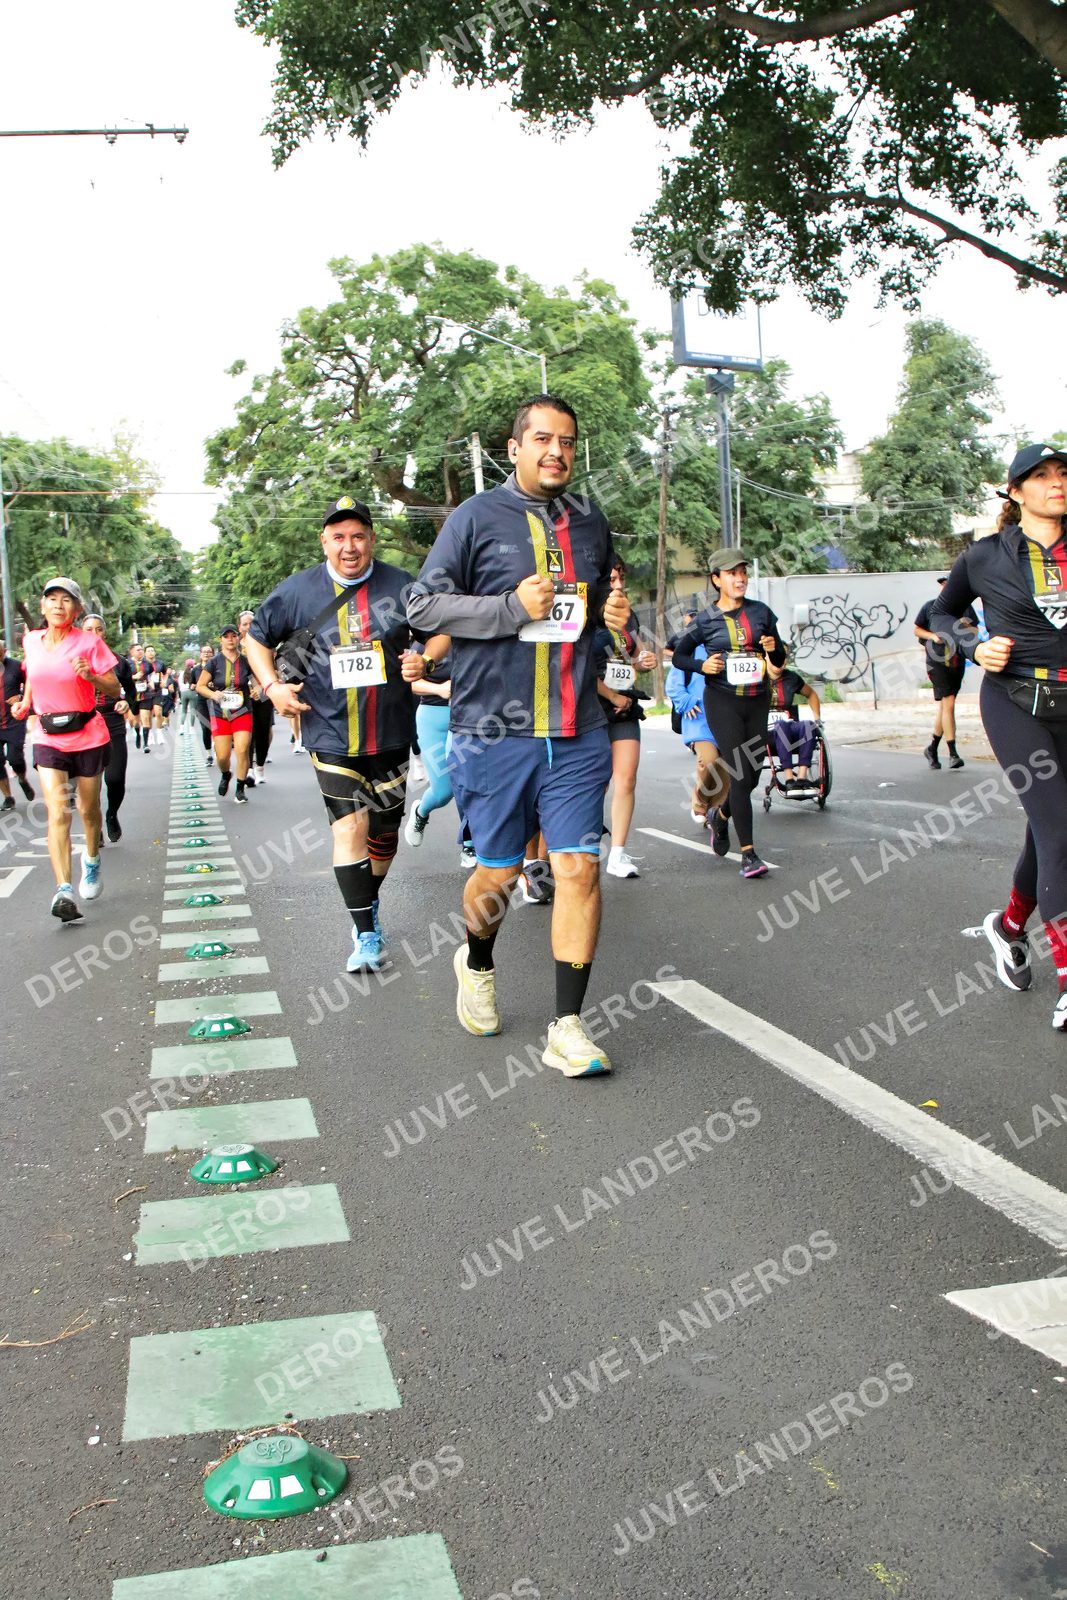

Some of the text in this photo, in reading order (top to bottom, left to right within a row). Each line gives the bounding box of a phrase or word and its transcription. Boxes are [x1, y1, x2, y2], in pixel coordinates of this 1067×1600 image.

[809, 593, 850, 608] TOY
[338, 656, 373, 673] 1782
[733, 662, 757, 673] 1823
[611, 667, 631, 679] 1832
